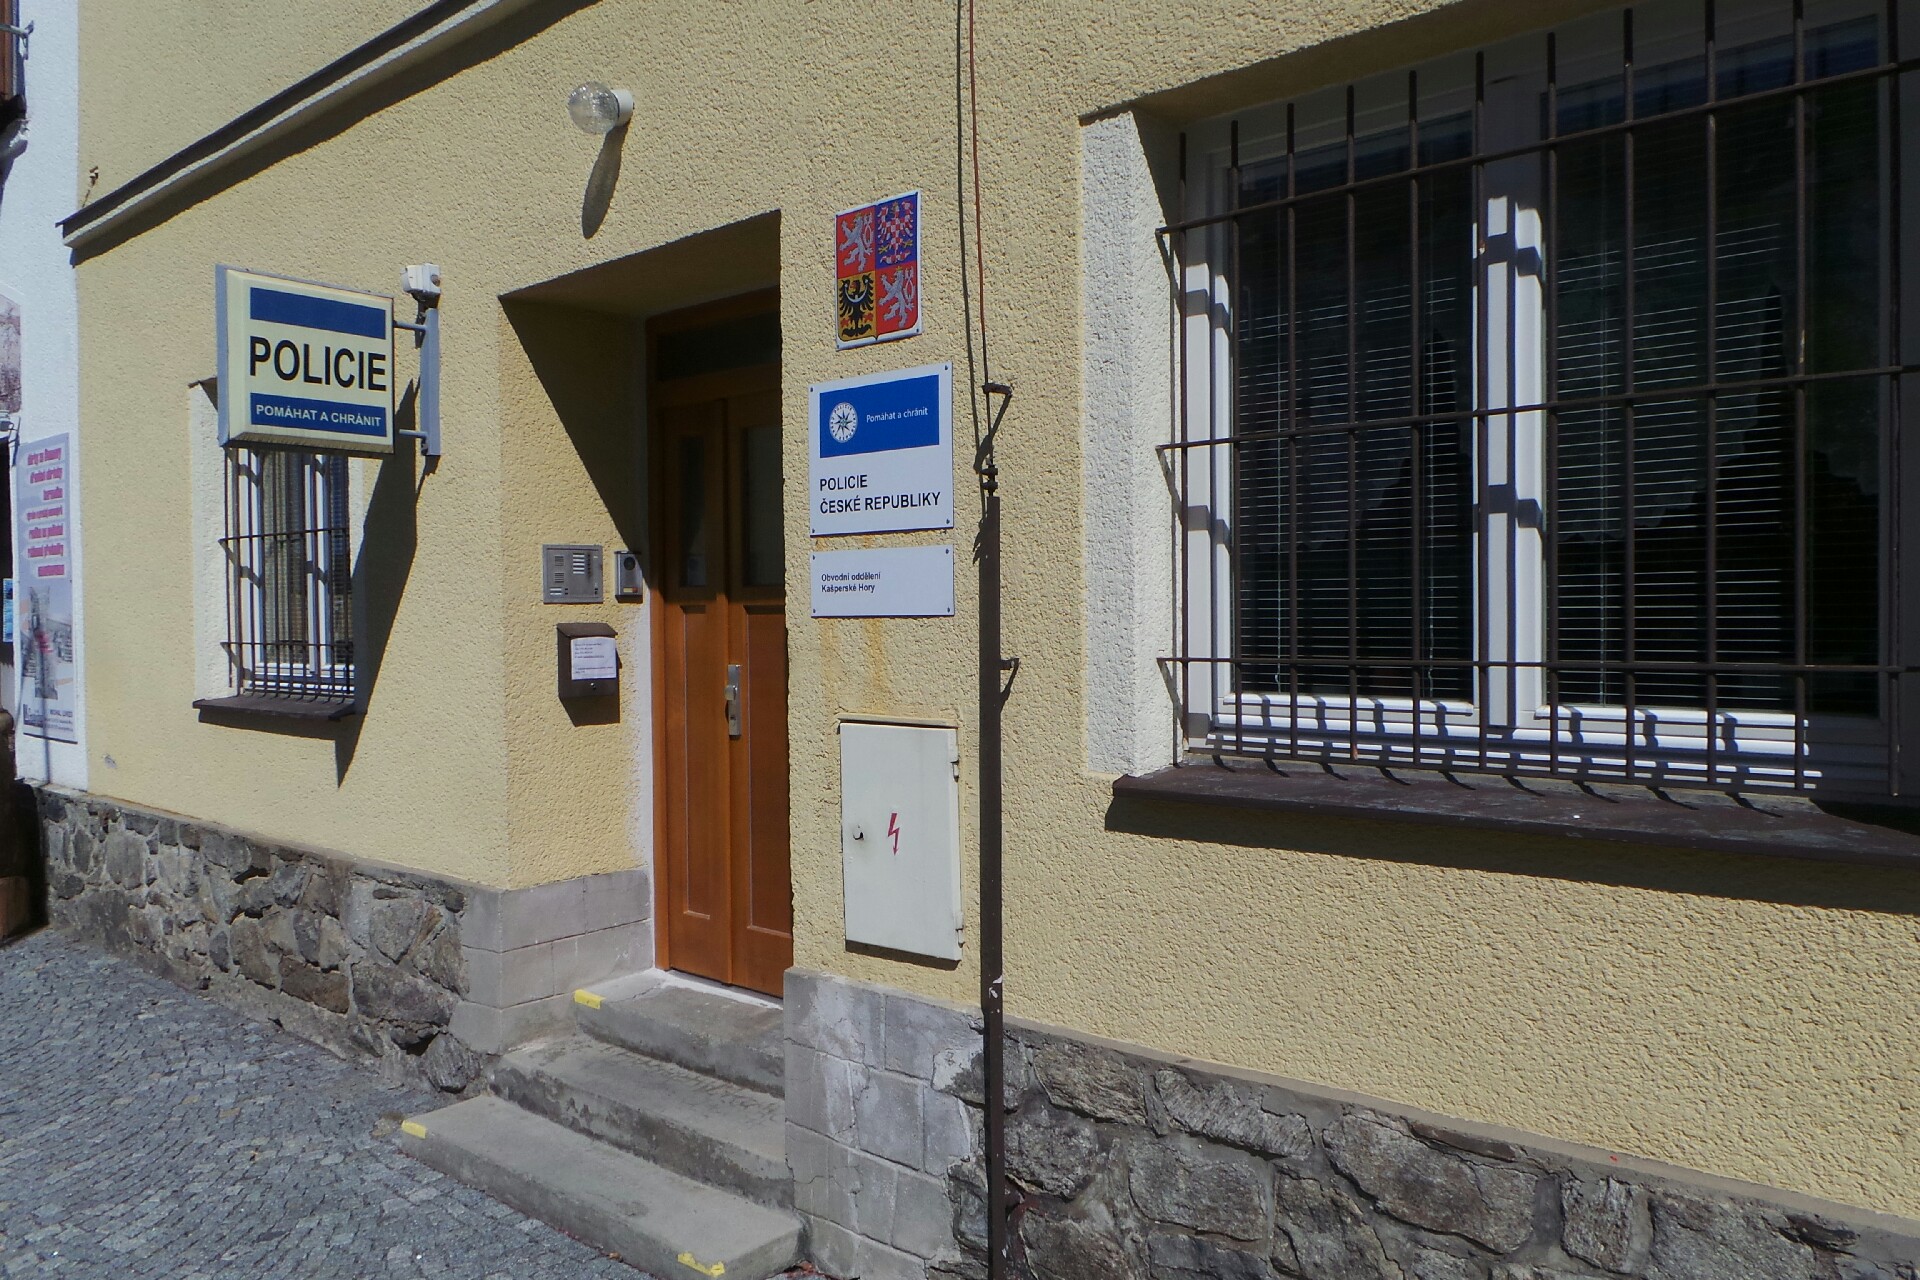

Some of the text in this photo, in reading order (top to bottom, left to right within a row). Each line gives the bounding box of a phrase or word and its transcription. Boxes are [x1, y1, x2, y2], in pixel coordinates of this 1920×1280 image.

[250, 335, 387, 392] POLICIE
[256, 404, 382, 427] POMÁHAT A CHRÁNIT
[866, 411, 896, 423] Pomáhat
[903, 406, 928, 418] chránit
[819, 474, 868, 491] POLICIE
[820, 491, 941, 514] ČESKÉ REPUBLIKY
[821, 571, 881, 582] Obvodní oddělení
[821, 583, 875, 594] Kašperské Hory
